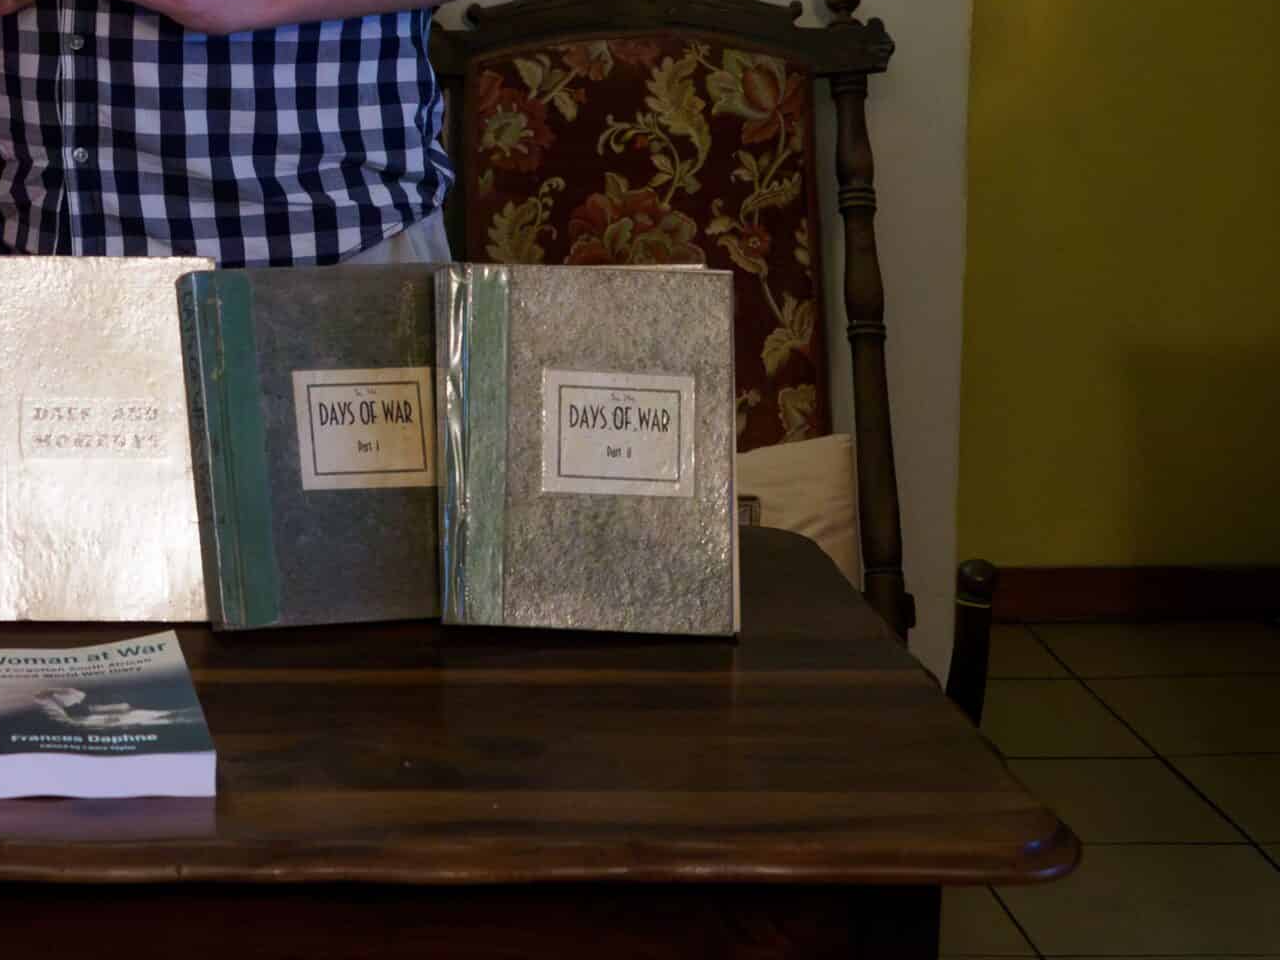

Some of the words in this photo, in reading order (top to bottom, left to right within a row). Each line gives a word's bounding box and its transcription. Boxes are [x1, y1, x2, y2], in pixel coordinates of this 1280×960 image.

[319, 401, 355, 426] DAYS
[359, 400, 377, 425] OF
[382, 400, 413, 424] WAR
[569, 404, 608, 429] DAYS
[613, 406, 632, 431] OF
[638, 407, 670, 432] WAR
[357, 440, 373, 452] Part
[607, 446, 621, 458] Part
[88, 651, 111, 662] at
[116, 642, 167, 657] War
[11, 734, 83, 743] Frances
[87, 733, 158, 744] Daphne
